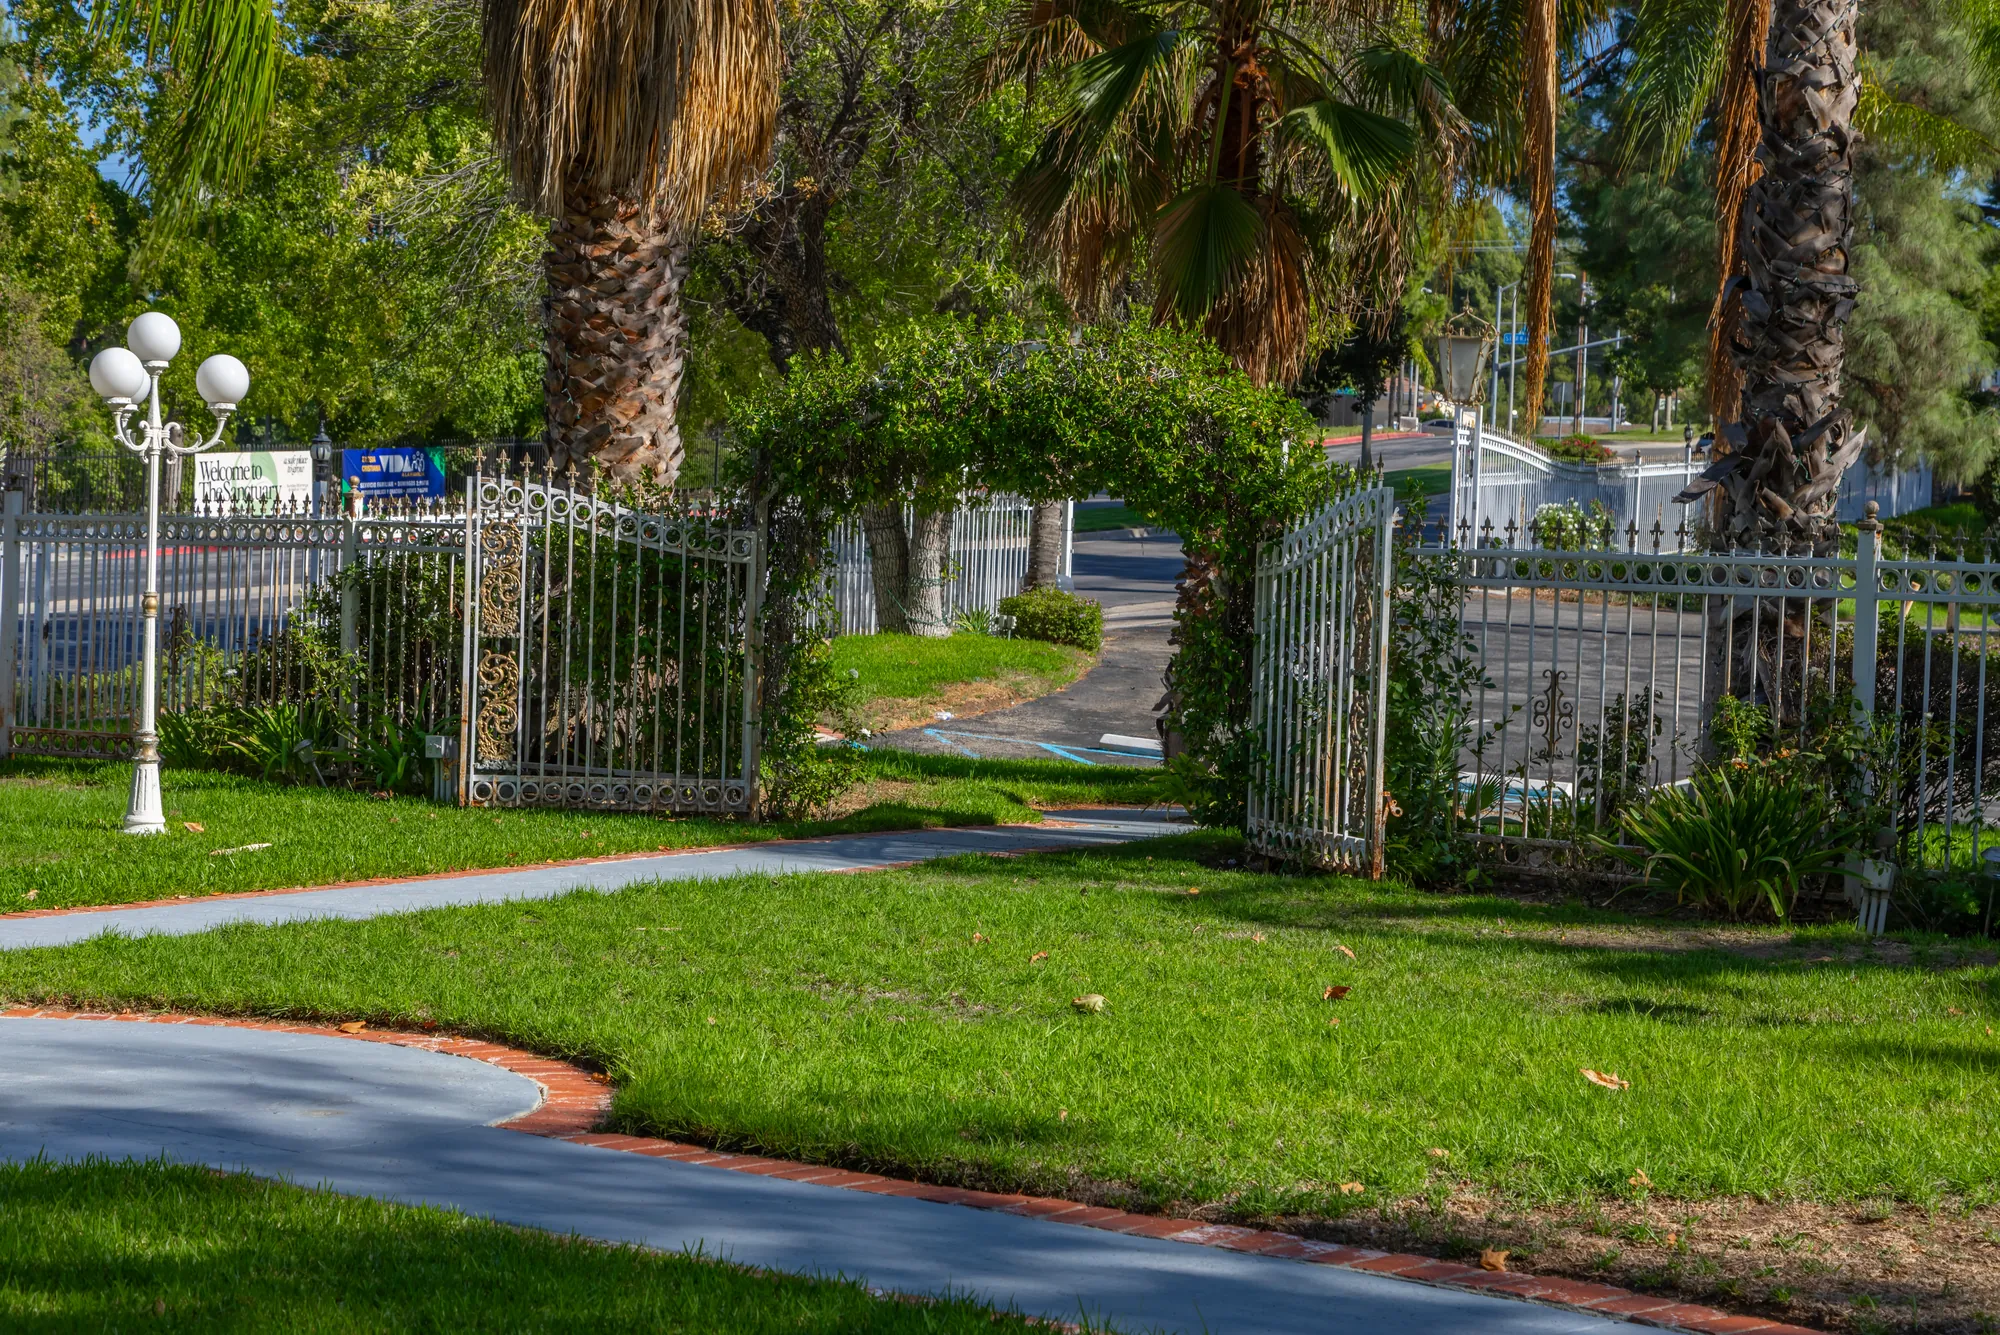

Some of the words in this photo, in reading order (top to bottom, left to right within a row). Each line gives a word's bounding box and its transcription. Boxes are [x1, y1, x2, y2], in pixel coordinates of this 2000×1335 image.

[199, 460, 250, 481] Welcome
[251, 463, 263, 480] to
[379, 454, 413, 473] VIDA
[199, 481, 223, 501] The
[223, 481, 282, 502] Sanctuary
